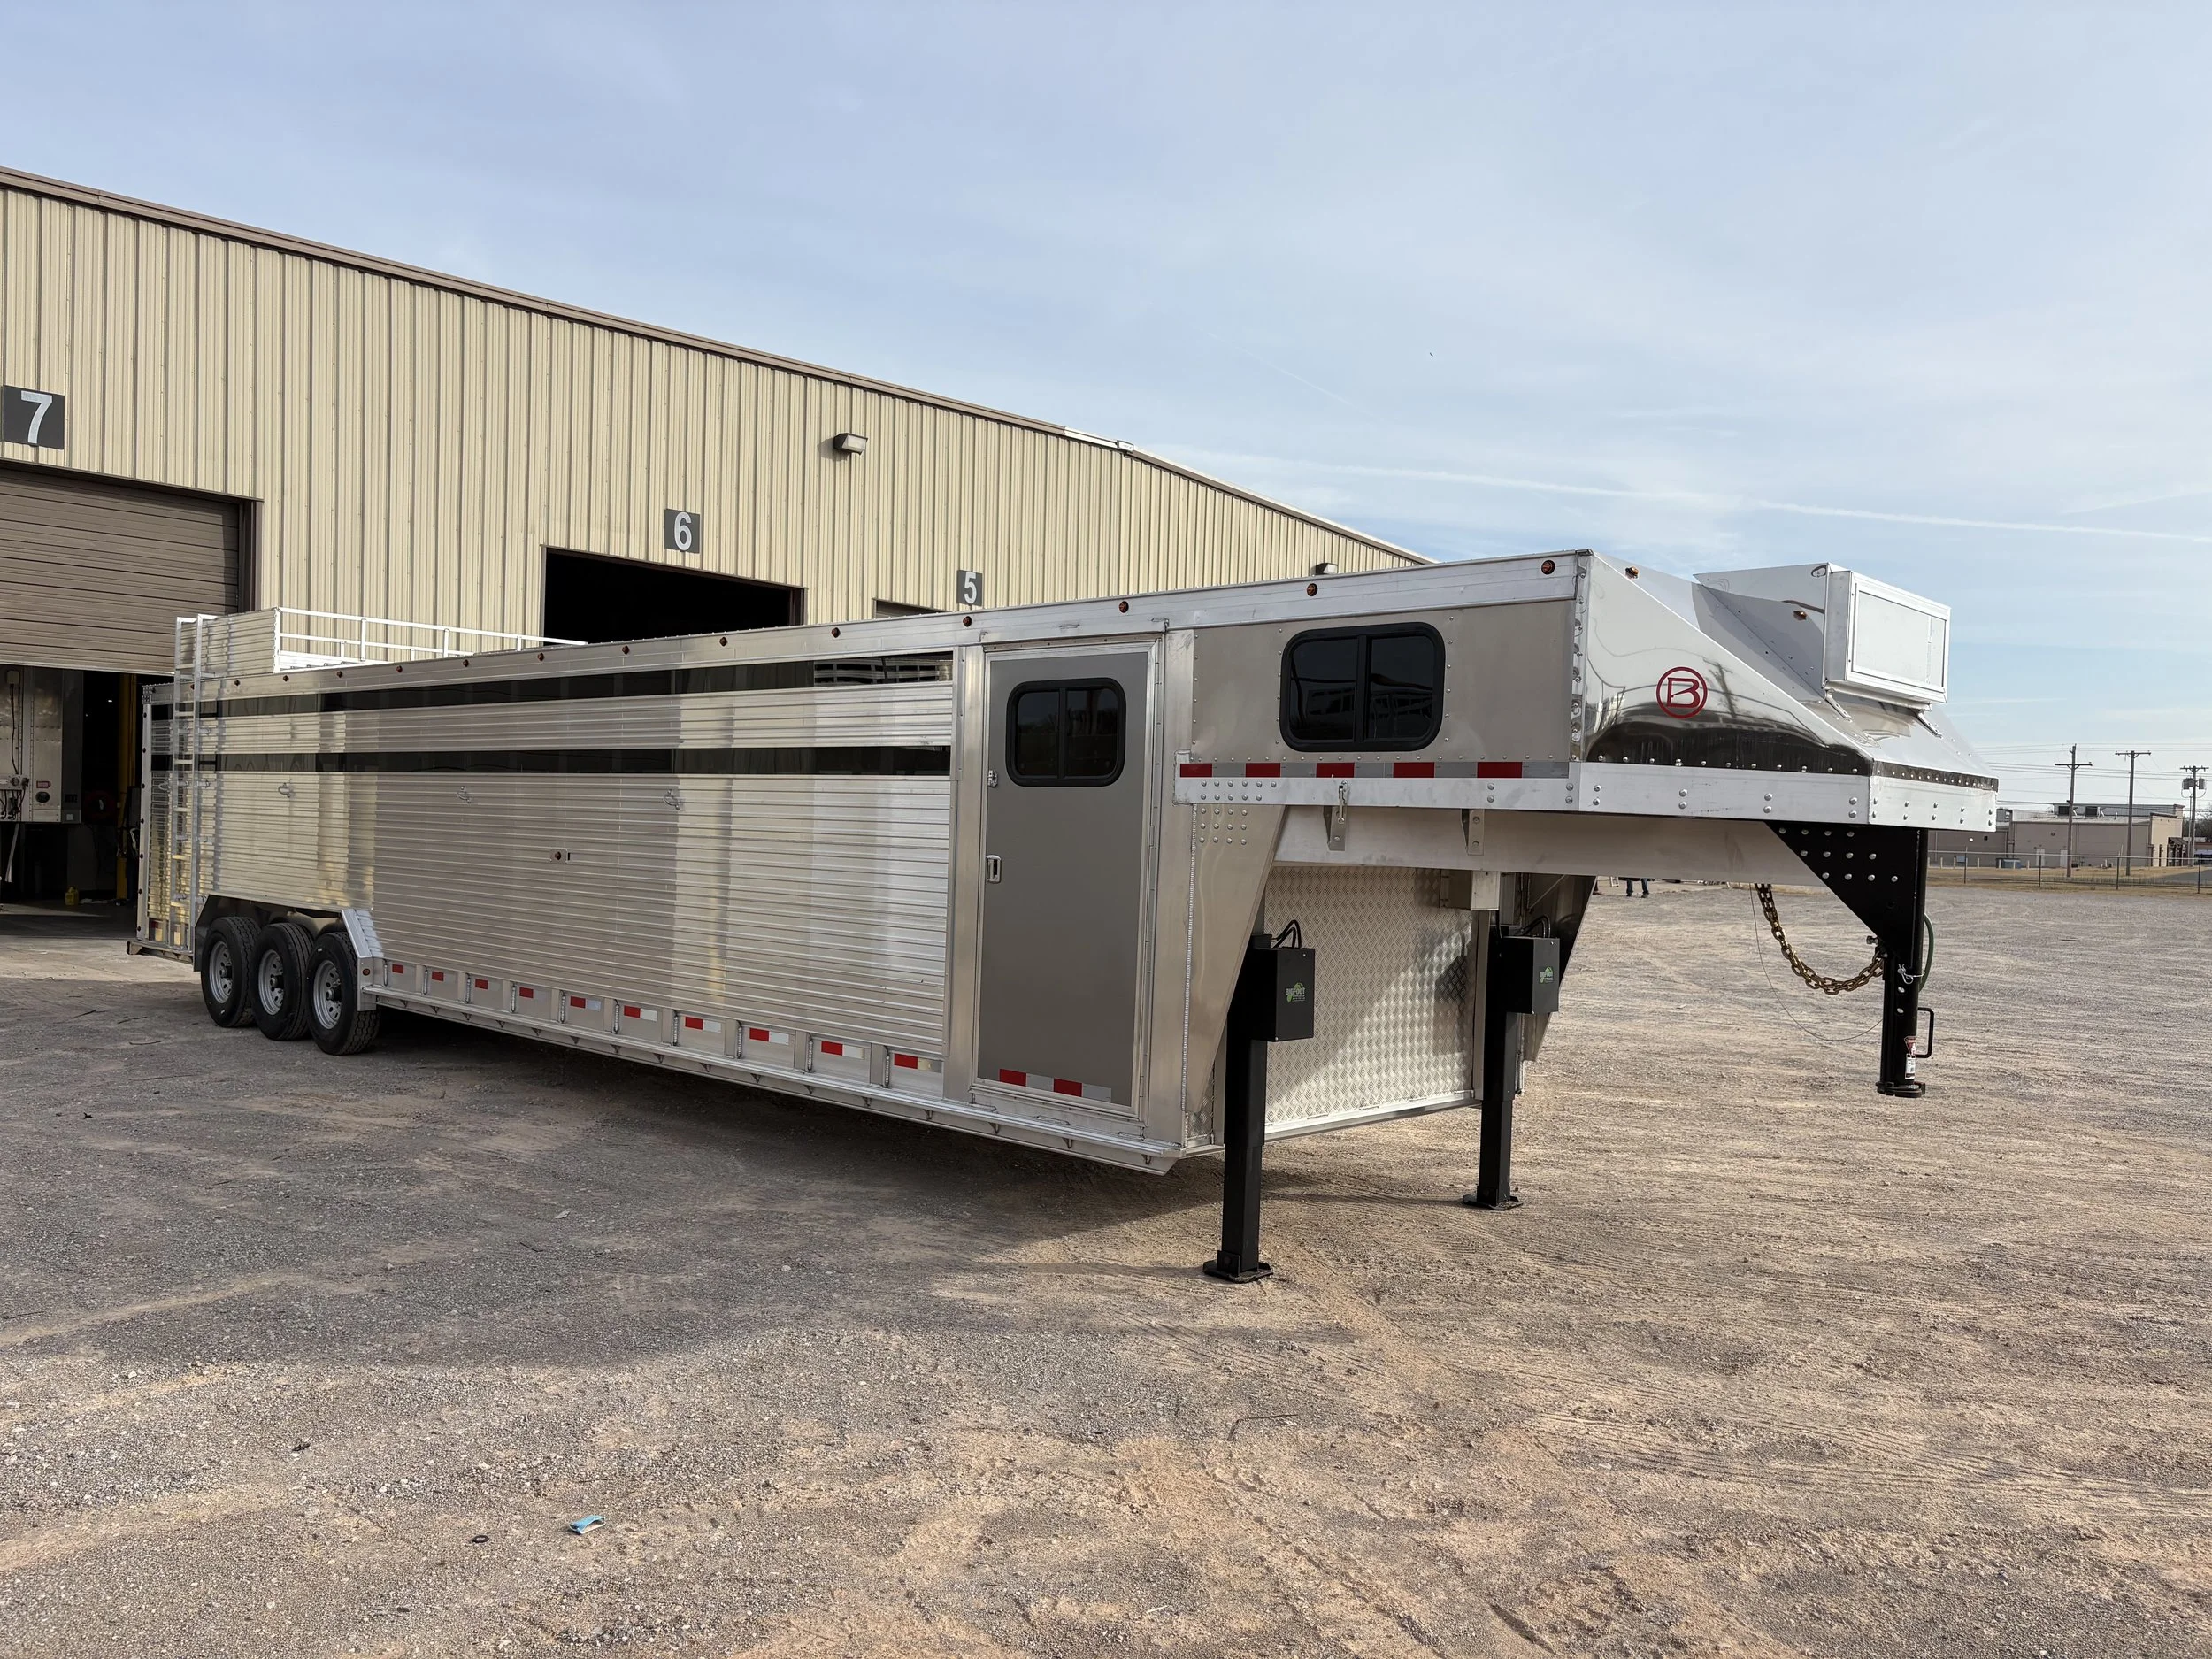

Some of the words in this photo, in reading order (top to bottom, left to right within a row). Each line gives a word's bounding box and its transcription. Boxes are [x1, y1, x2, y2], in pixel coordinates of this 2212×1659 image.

[21, 390, 52, 444] 7
[674, 511, 692, 551] 6
[964, 572, 977, 604] 5
[1667, 678, 1700, 708] B
